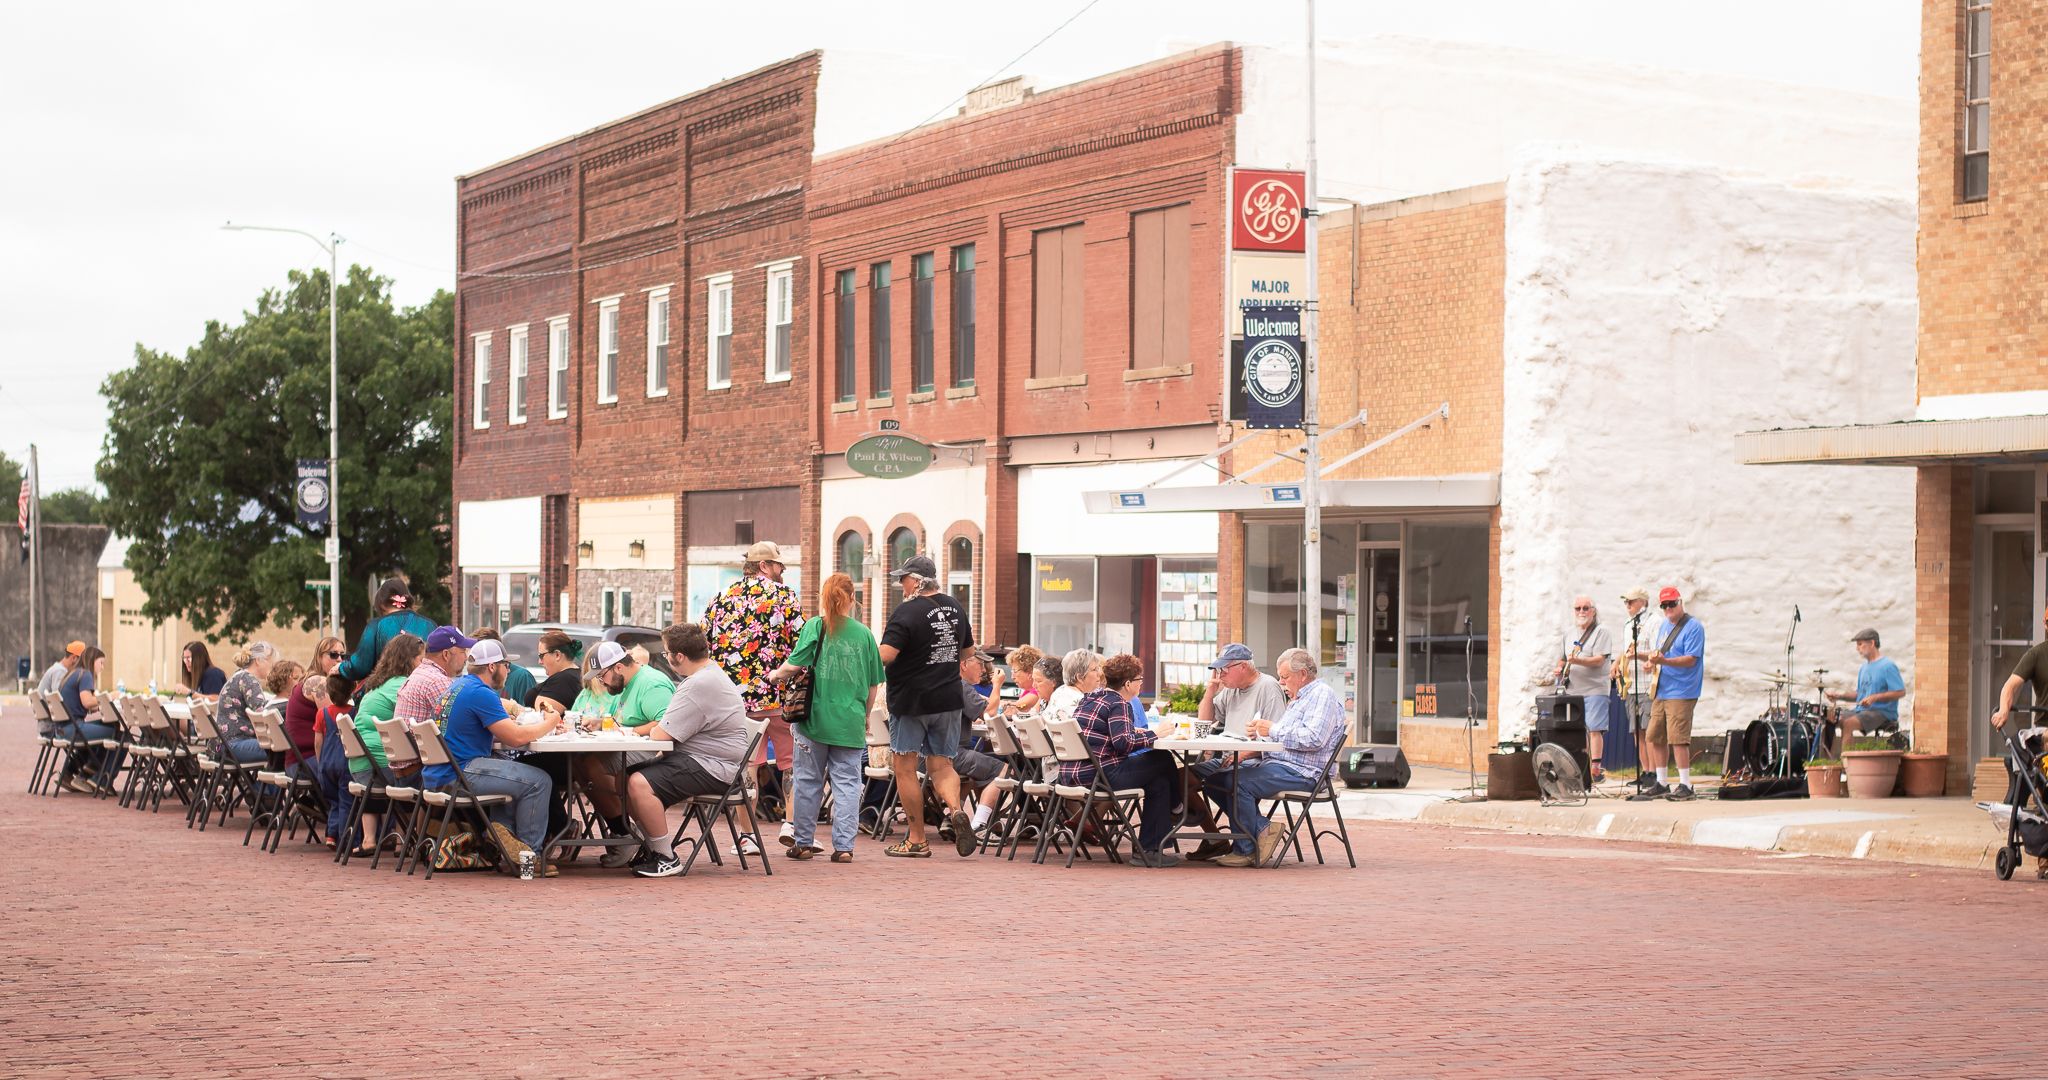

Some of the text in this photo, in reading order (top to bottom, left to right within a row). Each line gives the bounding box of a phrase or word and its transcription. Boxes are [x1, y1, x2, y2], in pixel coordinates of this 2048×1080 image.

[1253, 192, 1291, 233] GE
[1251, 279, 1290, 294] MAJOR
[1245, 317, 1299, 337] Welcome
[1249, 346, 1299, 380] CITY OF MANKATO
[1263, 392, 1287, 402] KANSAS
[854, 452, 922, 462] Paul R. Wilson
